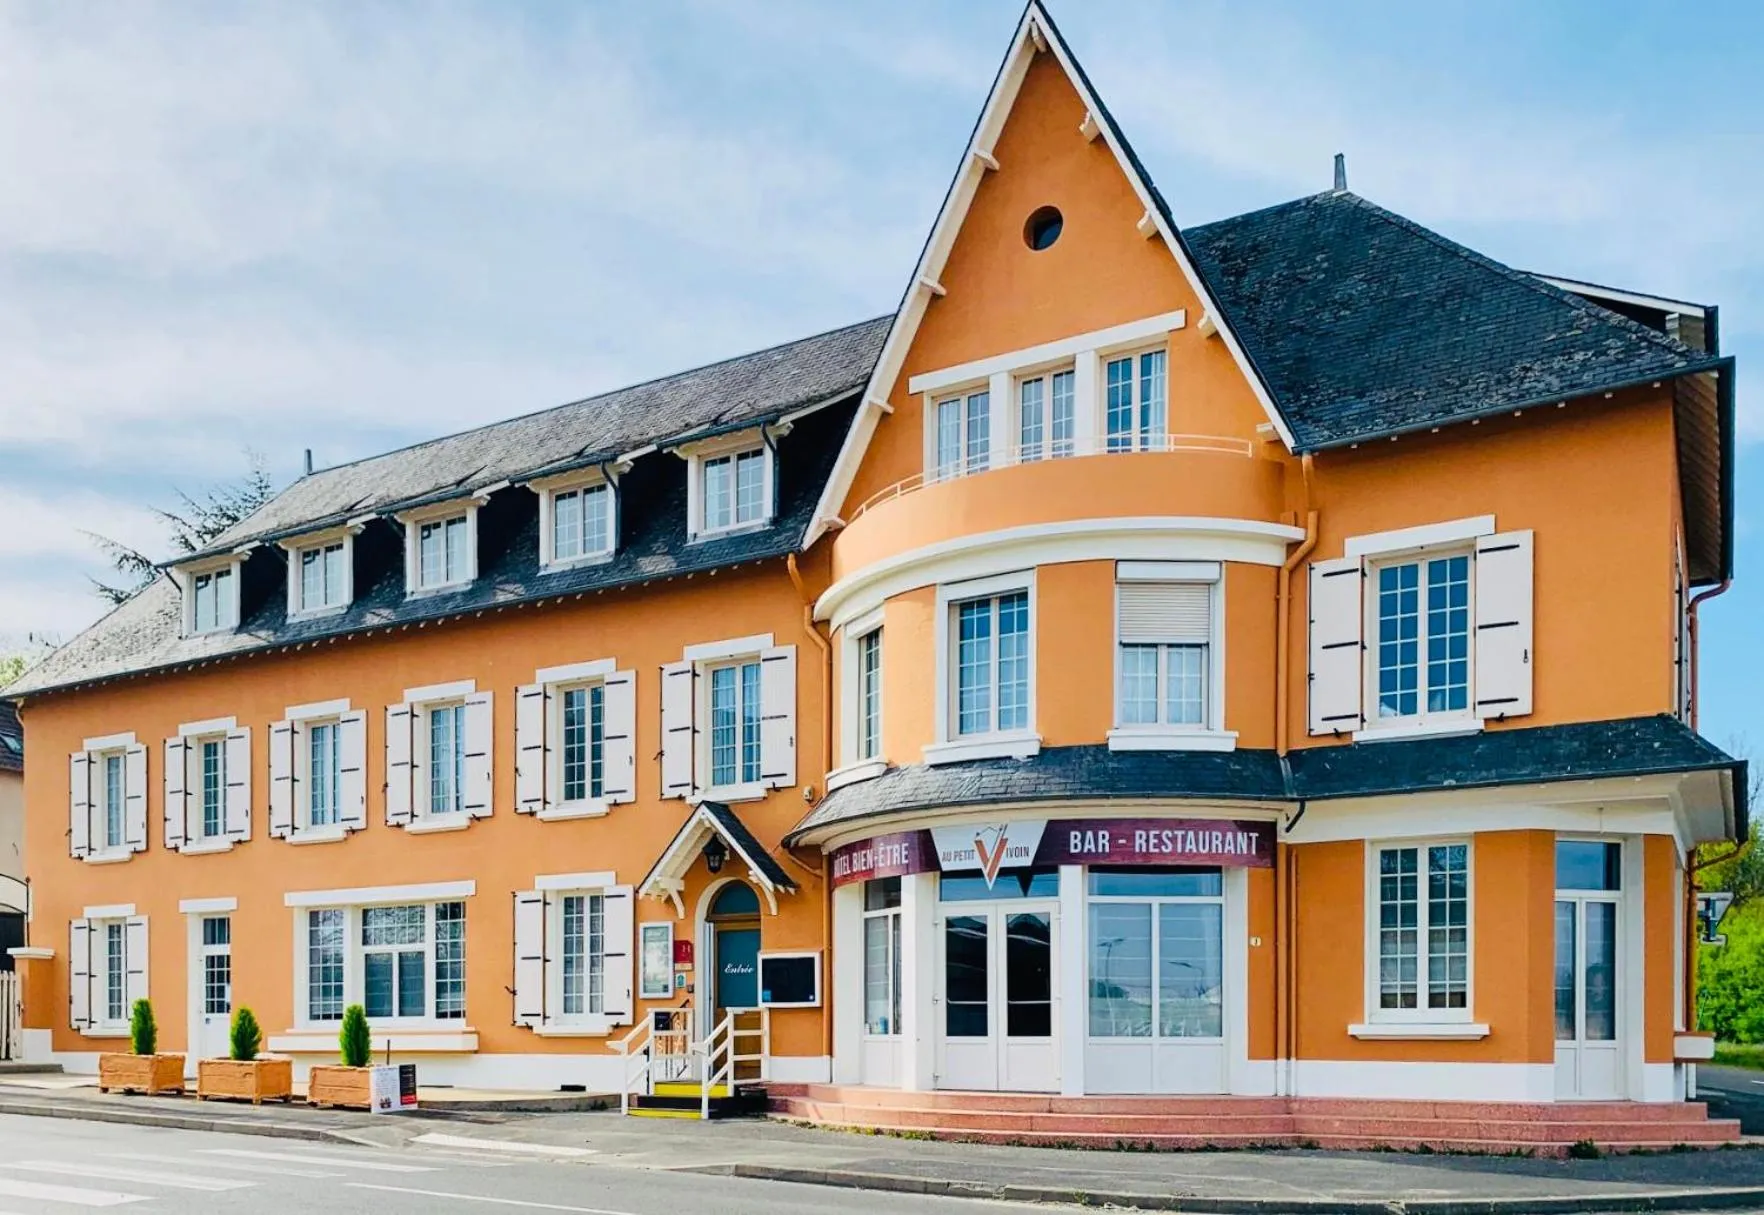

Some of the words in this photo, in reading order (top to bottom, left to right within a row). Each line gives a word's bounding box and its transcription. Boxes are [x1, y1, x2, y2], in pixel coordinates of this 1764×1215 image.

[1069, 830, 1110, 853] BAR
[1135, 830, 1259, 855] RESTAURANT
[942, 850, 953, 862] AU
[953, 849, 975, 862] PETIT
